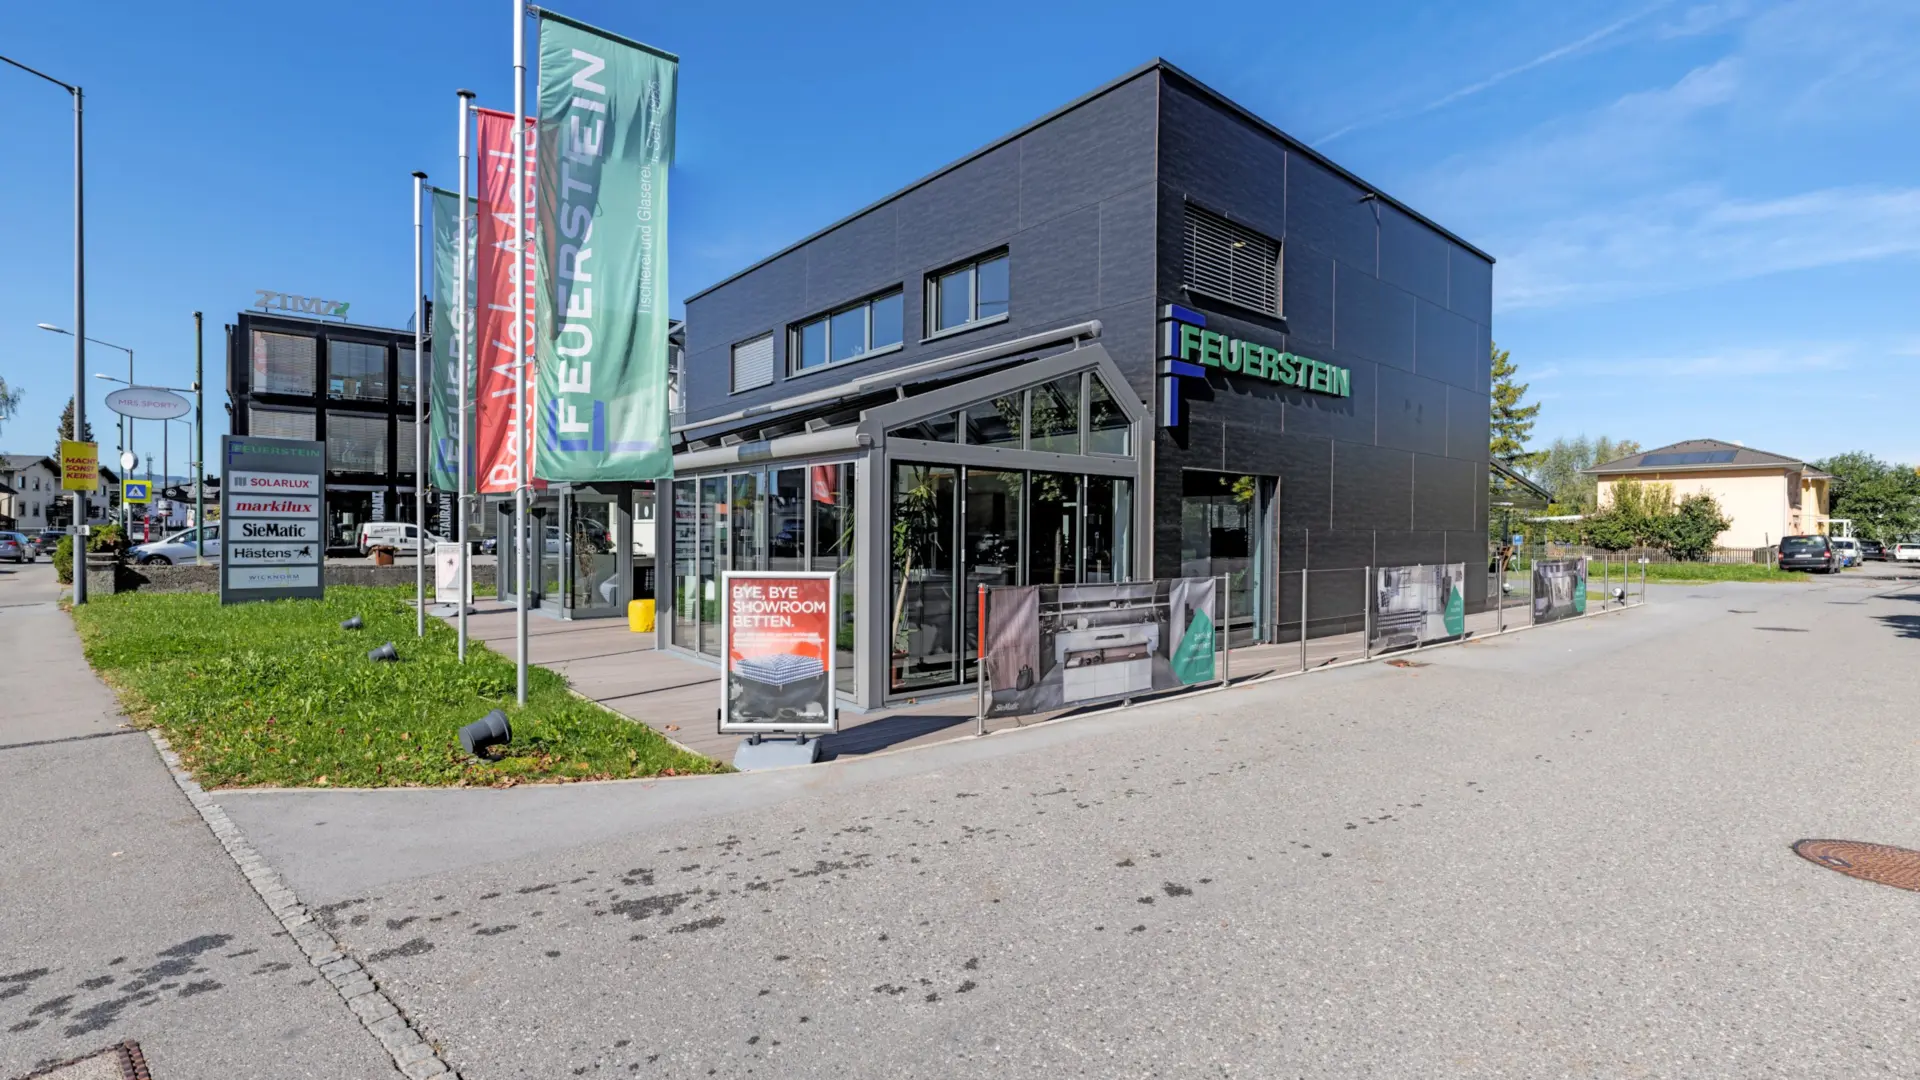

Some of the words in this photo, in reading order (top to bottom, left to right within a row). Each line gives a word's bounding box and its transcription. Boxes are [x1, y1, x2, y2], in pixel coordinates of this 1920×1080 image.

[556, 48, 606, 433] FEUERSTEIN
[639, 225, 652, 250] und
[1180, 323, 1350, 397] FEUERSTEIN
[232, 444, 320, 457] FEUERSTEIN
[250, 478, 309, 488] SOLARLUX
[235, 501, 312, 512] markilux
[439, 493, 452, 540] STAURANT
[242, 523, 306, 537] SieMatic
[234, 547, 292, 559] Hästens
[733, 586, 766, 600] BYE,
[769, 586, 798, 599] BYE
[732, 601, 826, 613] SHOWROOM
[733, 616, 795, 628] BETTEN.
